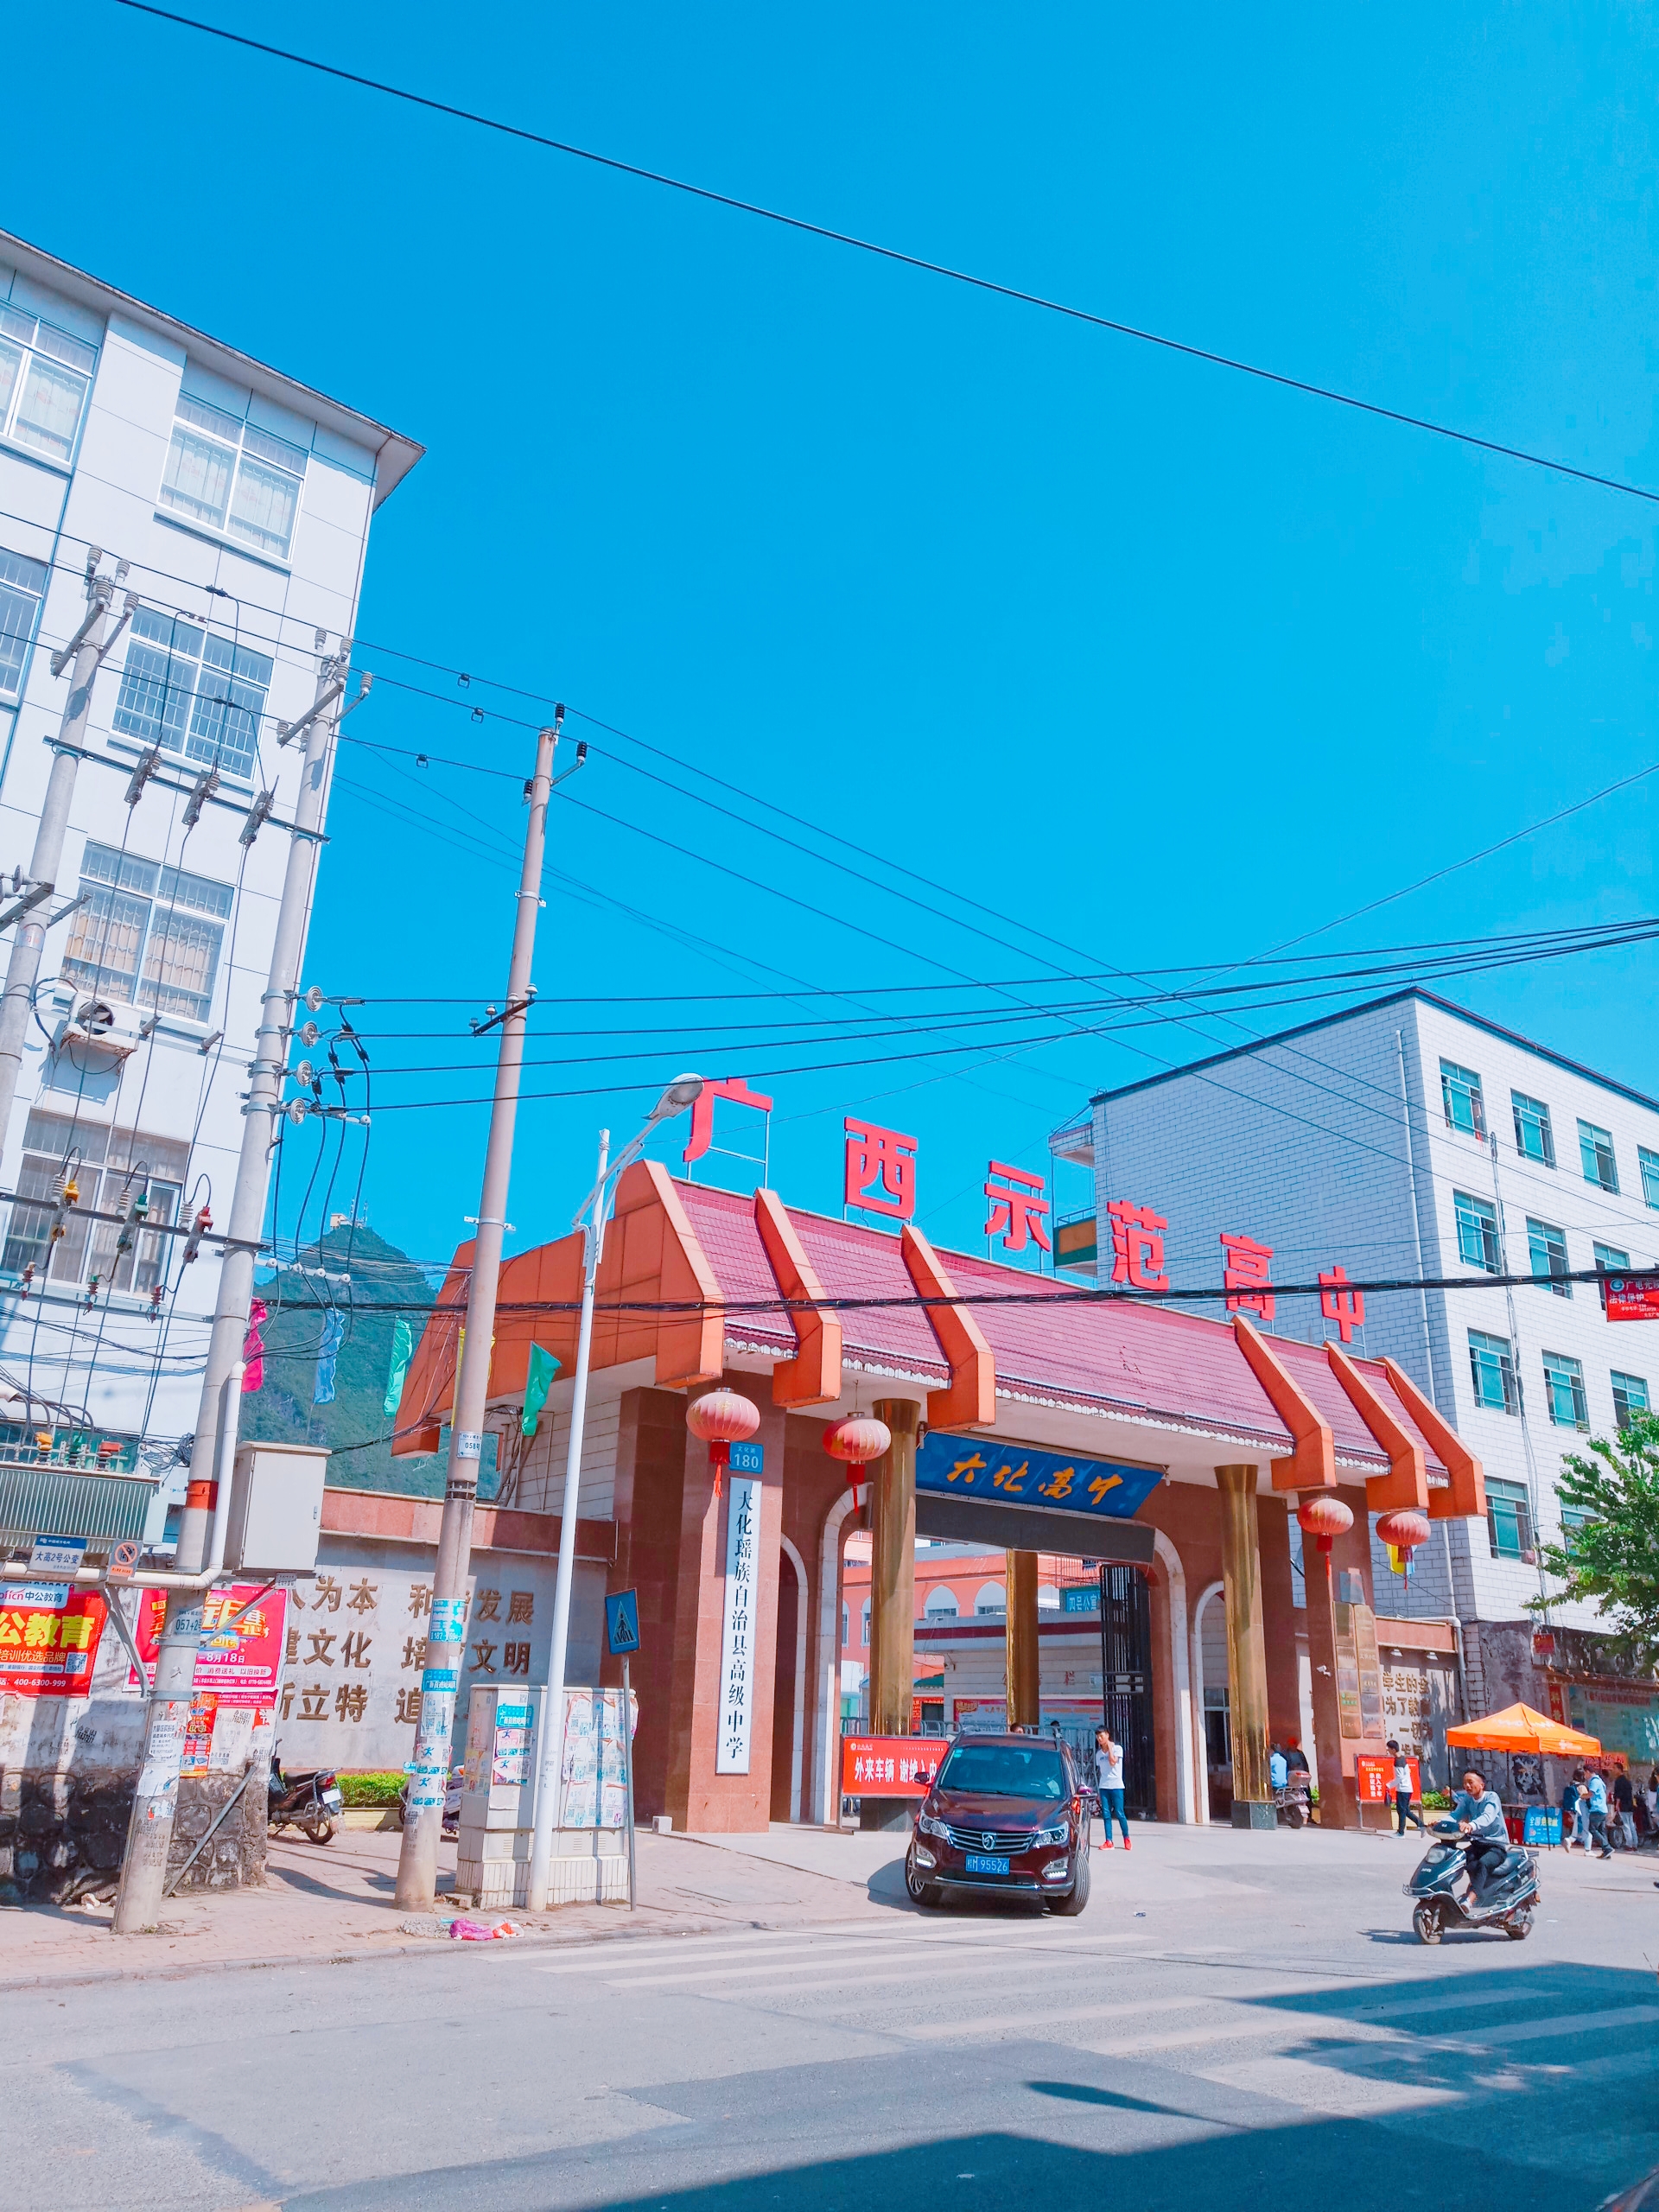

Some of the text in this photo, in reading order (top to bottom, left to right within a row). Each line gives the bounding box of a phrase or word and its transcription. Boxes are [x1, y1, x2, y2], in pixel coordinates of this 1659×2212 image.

[682, 1077, 1365, 1344] 广西示范高中
[734, 1453, 759, 1469] 180
[946, 1452, 1123, 1505] 大化高中
[35, 1551, 79, 1564] 大高2号公变
[25, 1591, 64, 1604] 中公教育
[408, 1583, 534, 1626] 和发展
[0, 1611, 96, 1649] 公教育
[726, 1491, 753, 1759] 大化瑶族自治县高级中学
[401, 1636, 531, 1675] 培文明
[14, 1678, 67, 1688] 400-6300-999
[855, 1756, 894, 1783] 外来车辆
